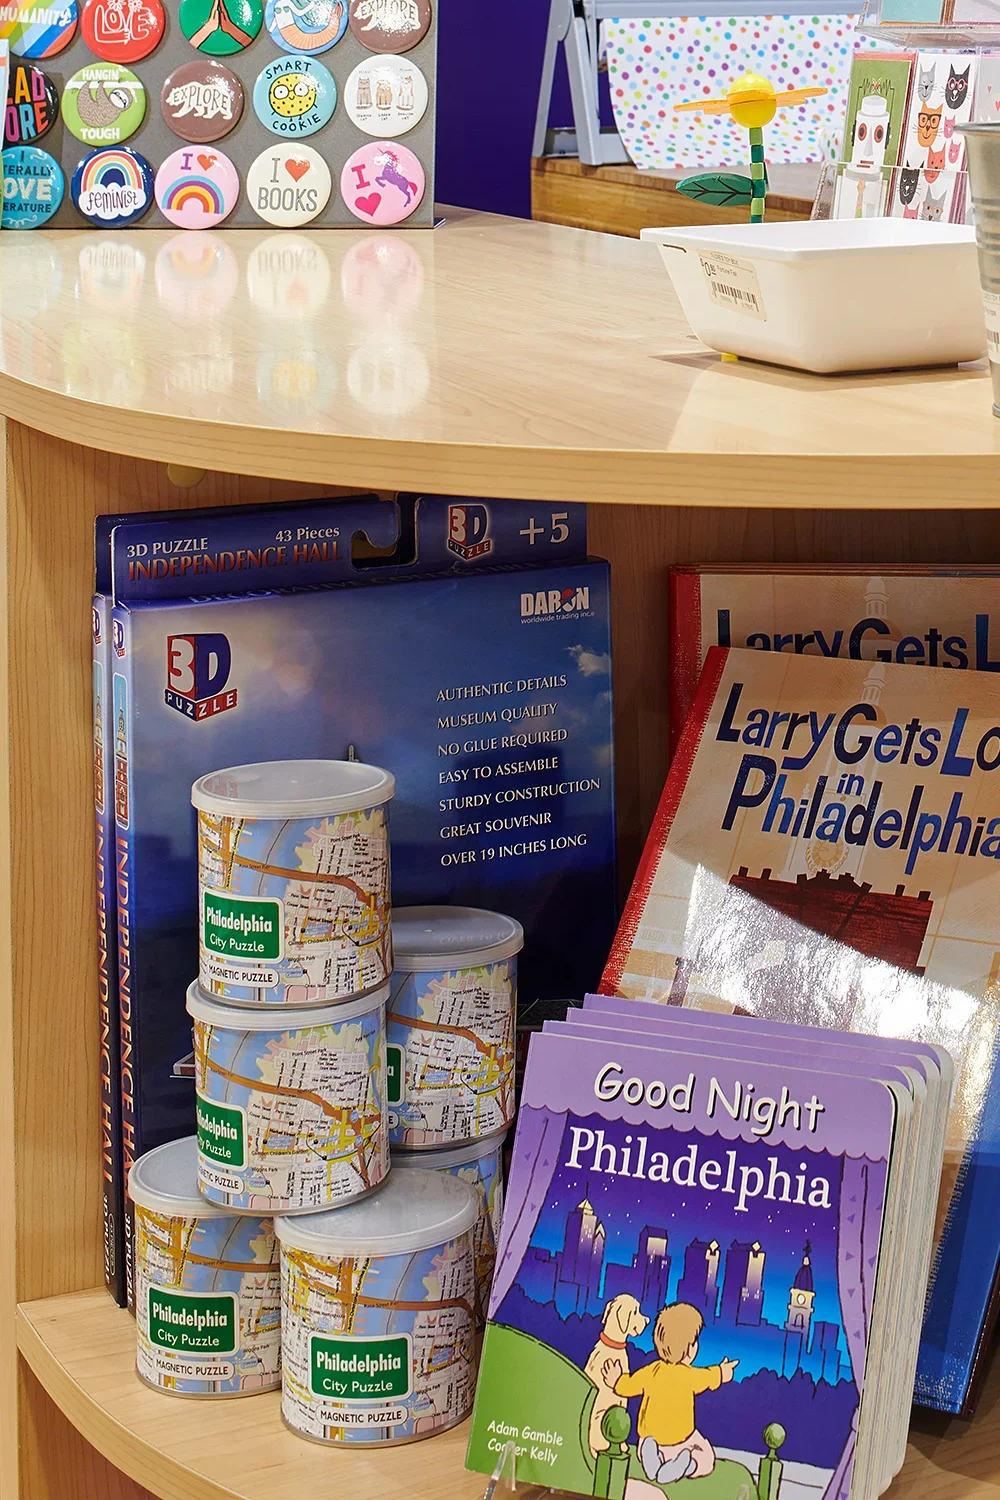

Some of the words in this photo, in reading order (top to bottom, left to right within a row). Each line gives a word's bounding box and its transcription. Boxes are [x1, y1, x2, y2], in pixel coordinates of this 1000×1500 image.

[173, 86, 228, 109] EXPLORE
[127, 543, 148, 558] 3D
[152, 538, 208, 555] PUZZLE
[275, 529, 293, 543] 43
[296, 525, 341, 541] Pieces
[128, 546, 288, 582] INDEPENDENCE
[293, 540, 343, 560] HALL
[521, 586, 590, 616] DARON
[521, 614, 555, 625] worldwide
[556, 613, 580, 623] trading
[167, 633, 232, 701] 3D
[436, 681, 514, 702] AUTHENTIC
[516, 674, 568, 692] DETAILS
[166, 689, 238, 719] PUZZLE
[437, 710, 498, 729] MUSEUM
[500, 703, 558, 723] QUALITY
[716, 683, 836, 771] Larry
[834, 703, 942, 768] Gets
[438, 741, 461, 757] NO
[464, 737, 498, 753] GLUE
[500, 728, 568, 749] REQUIRED
[438, 768, 470, 785] EASY
[472, 764, 492, 779] TO
[495, 756, 559, 777] ASSEMBLE
[838, 772, 864, 796] in
[439, 793, 493, 812] STURDY
[495, 778, 601, 804] CONSTRUCTION
[440, 822, 482, 840] GREAT
[485, 812, 552, 833] SOUVENIR
[440, 850, 476, 867] OVER
[480, 848, 495, 861] 19
[499, 840, 547, 859] INCHES
[550, 833, 588, 851] LONG
[206, 906, 273, 937] Philadelphia
[209, 933, 227, 951] City
[229, 937, 265, 953] Puzzle
[116, 836, 135, 1113] INDEPENDENCE
[594, 1061, 697, 1113] Good
[706, 1076, 826, 1136] Night
[565, 1125, 833, 1211] Philadelphia
[316, 1349, 402, 1379] Philadelphia
[322, 1378, 348, 1395] City
[351, 1378, 393, 1394] Puzzle
[320, 1410, 361, 1424] MAGNETIC
[363, 1409, 402, 1423] PUZZLE
[487, 1420, 519, 1438] Adam
[521, 1426, 564, 1446] Gamble
[487, 1438, 528, 1457] Coer
[530, 1446, 558, 1467] Kelly
